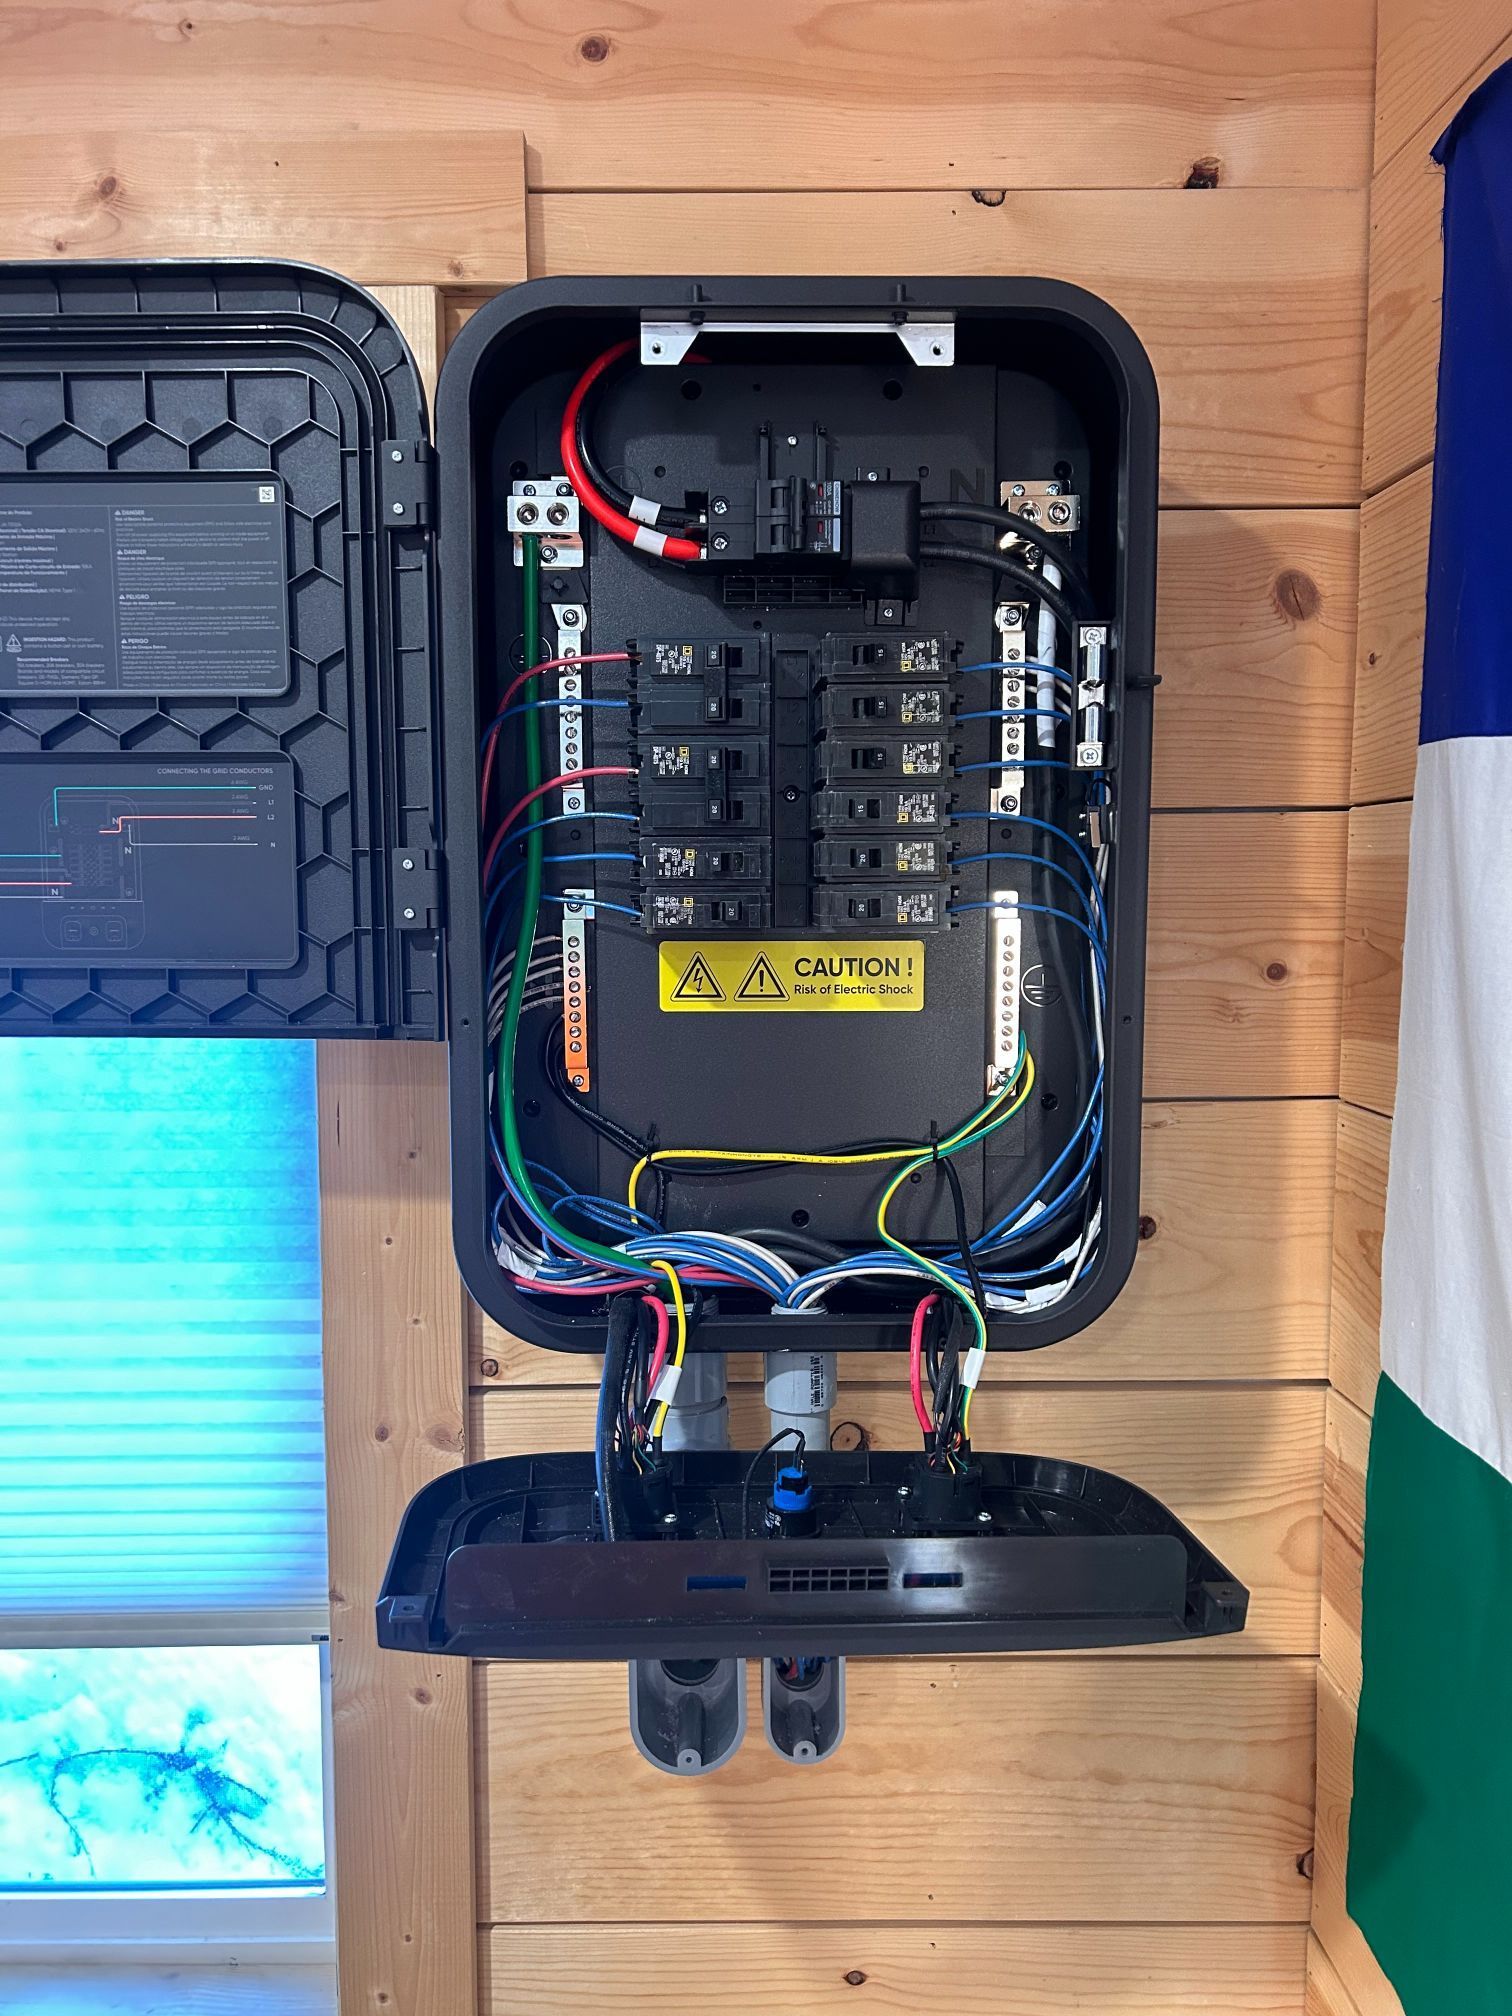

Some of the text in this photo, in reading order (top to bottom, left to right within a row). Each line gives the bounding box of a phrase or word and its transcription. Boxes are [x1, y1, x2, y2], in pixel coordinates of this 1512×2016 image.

[858, 804, 864, 812] 15
[51, 888, 59, 896] N
[728, 907, 735, 916] 20
[794, 957, 913, 977] CAUTION !
[794, 984, 914, 994] Risk of Electric Shock
